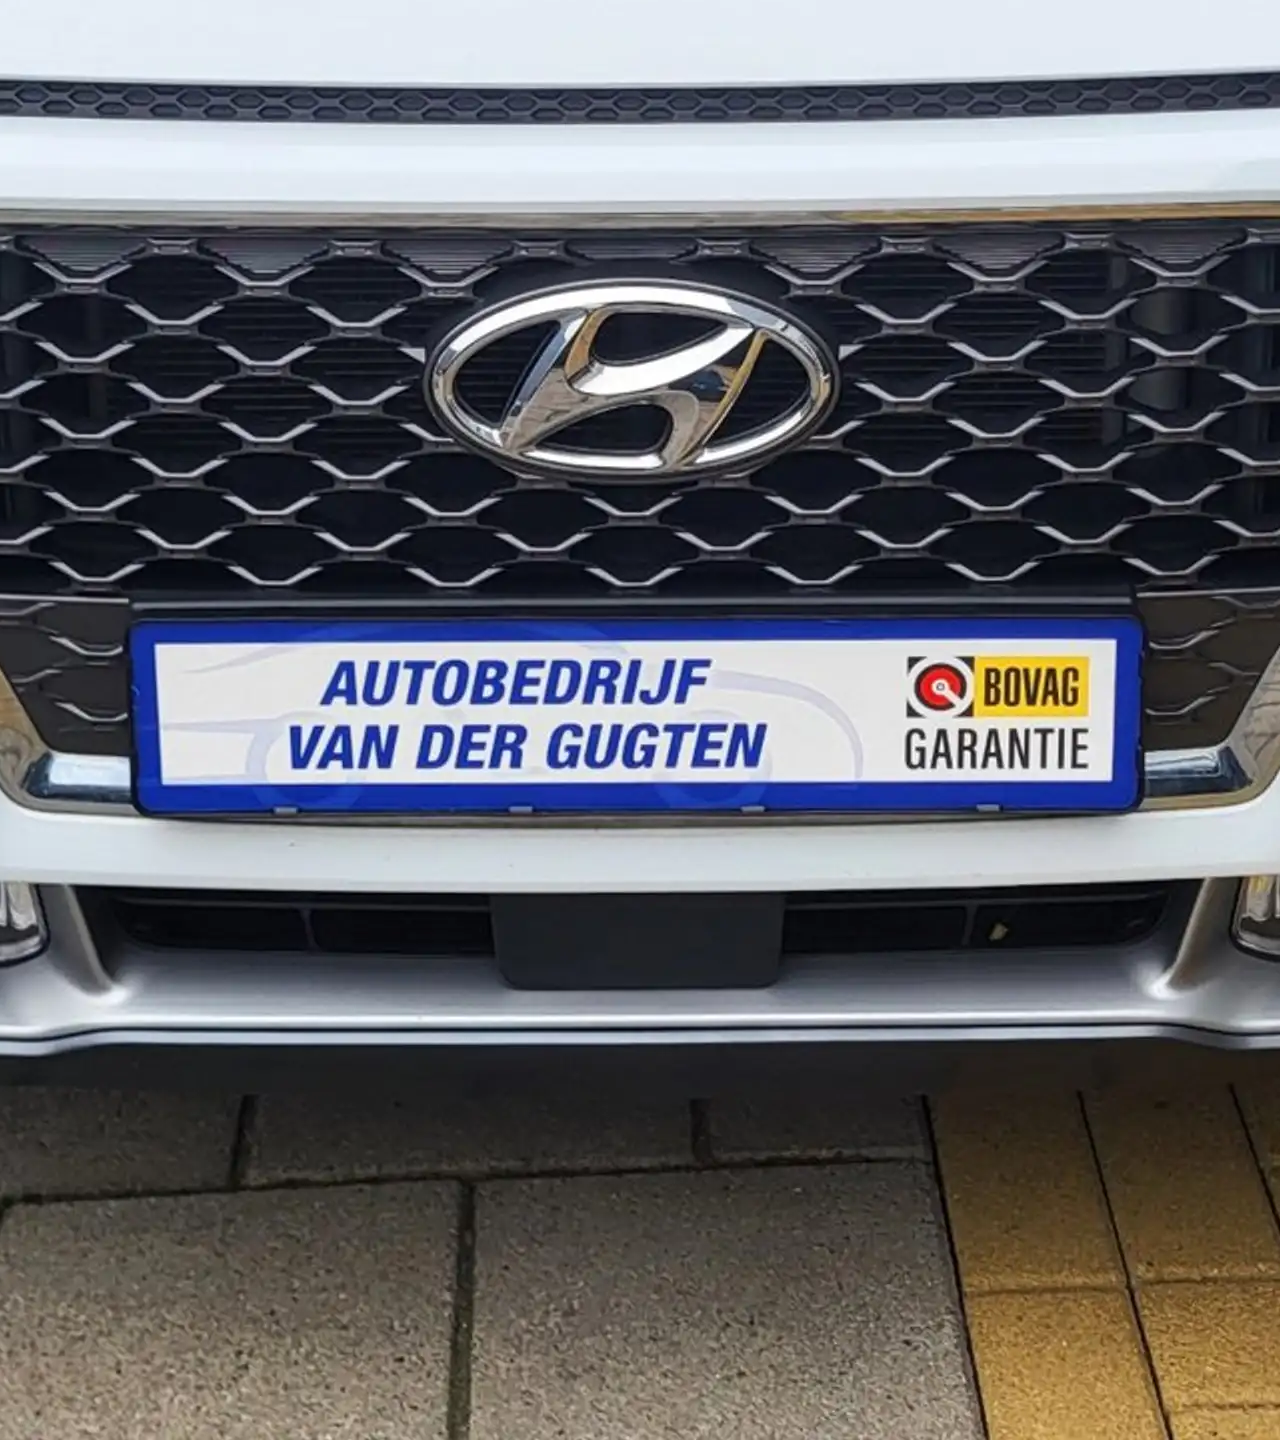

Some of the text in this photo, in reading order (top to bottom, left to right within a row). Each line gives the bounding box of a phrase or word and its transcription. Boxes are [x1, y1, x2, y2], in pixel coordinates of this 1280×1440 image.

[320, 659, 712, 706] AUTOBEDRIJF
[983, 666, 1080, 708] BOVAG
[289, 722, 768, 769] VAN DER GUGTEN
[904, 727, 1090, 770] GARANTIE
